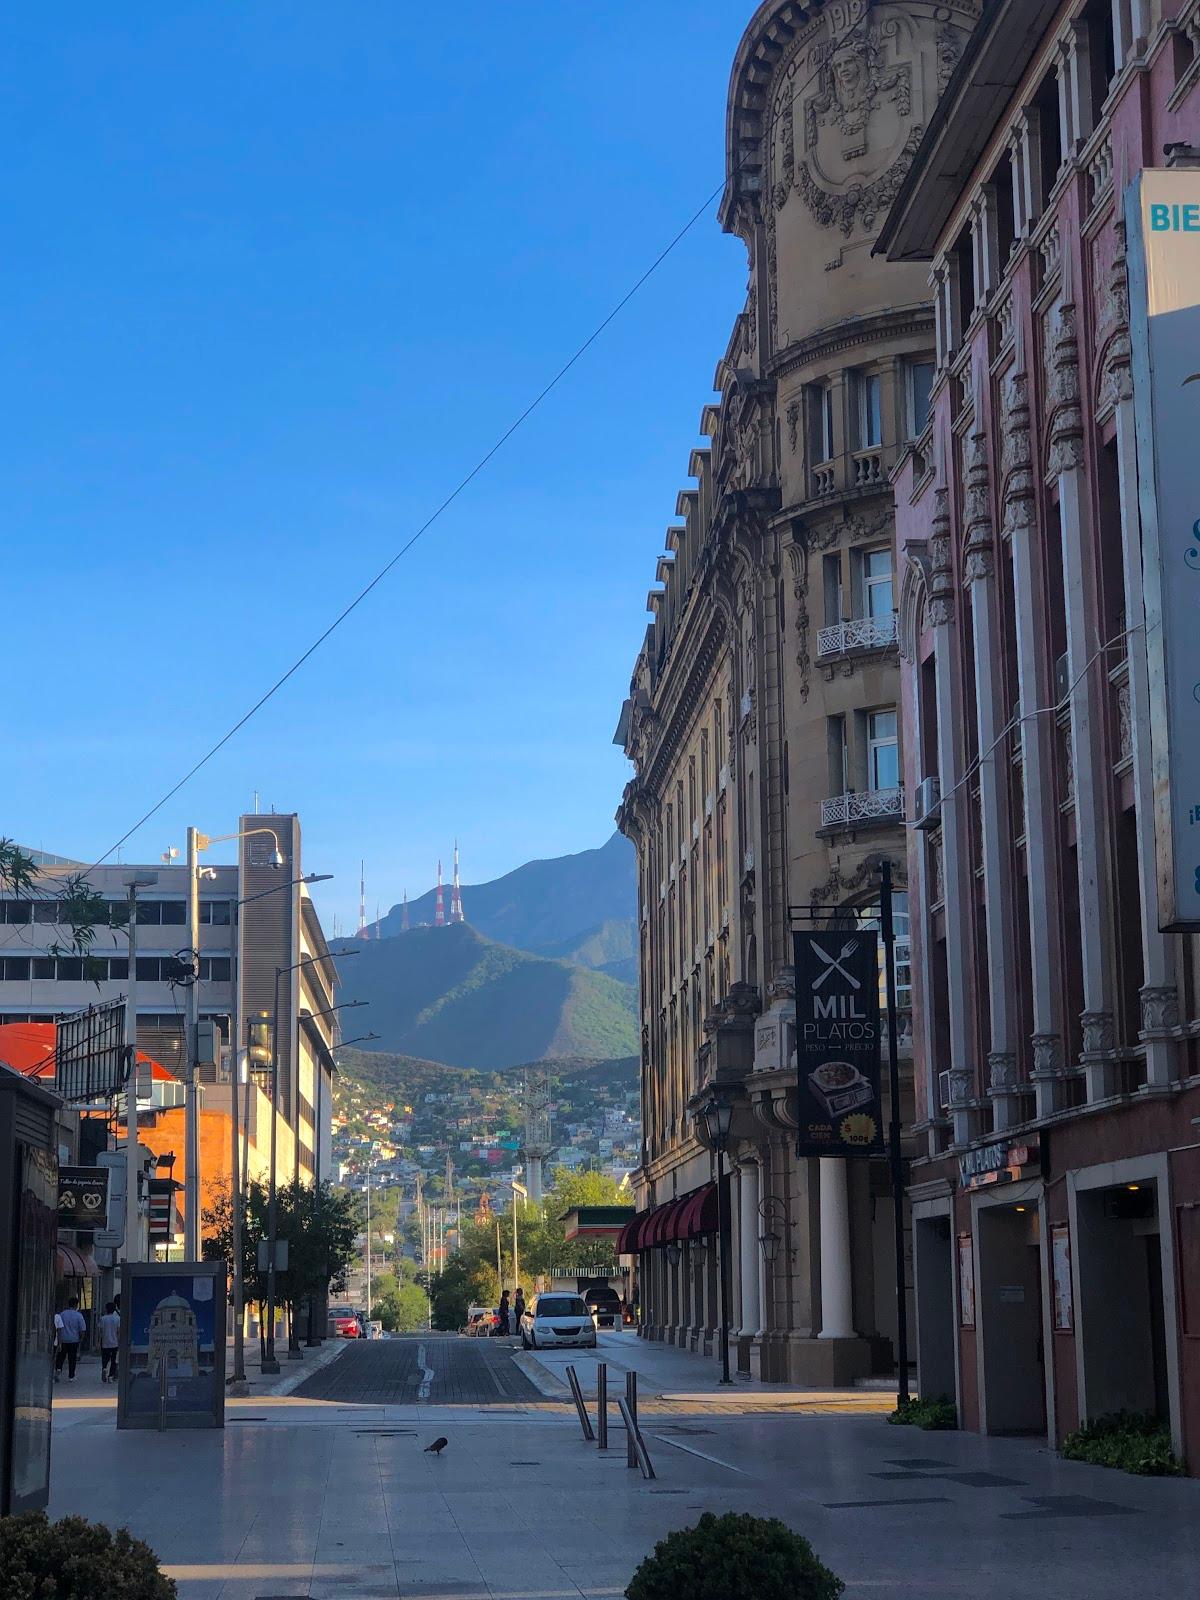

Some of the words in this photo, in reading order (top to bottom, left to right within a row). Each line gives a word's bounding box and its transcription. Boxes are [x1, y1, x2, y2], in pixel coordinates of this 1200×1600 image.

[828, 0, 863, 33] 1919
[813, 995, 866, 1019] MIL
[803, 1022, 875, 1040] PLATOS
[805, 1043, 825, 1051] PESO
[845, 1043, 874, 1051] PRECIO
[807, 1124, 833, 1132] CADA
